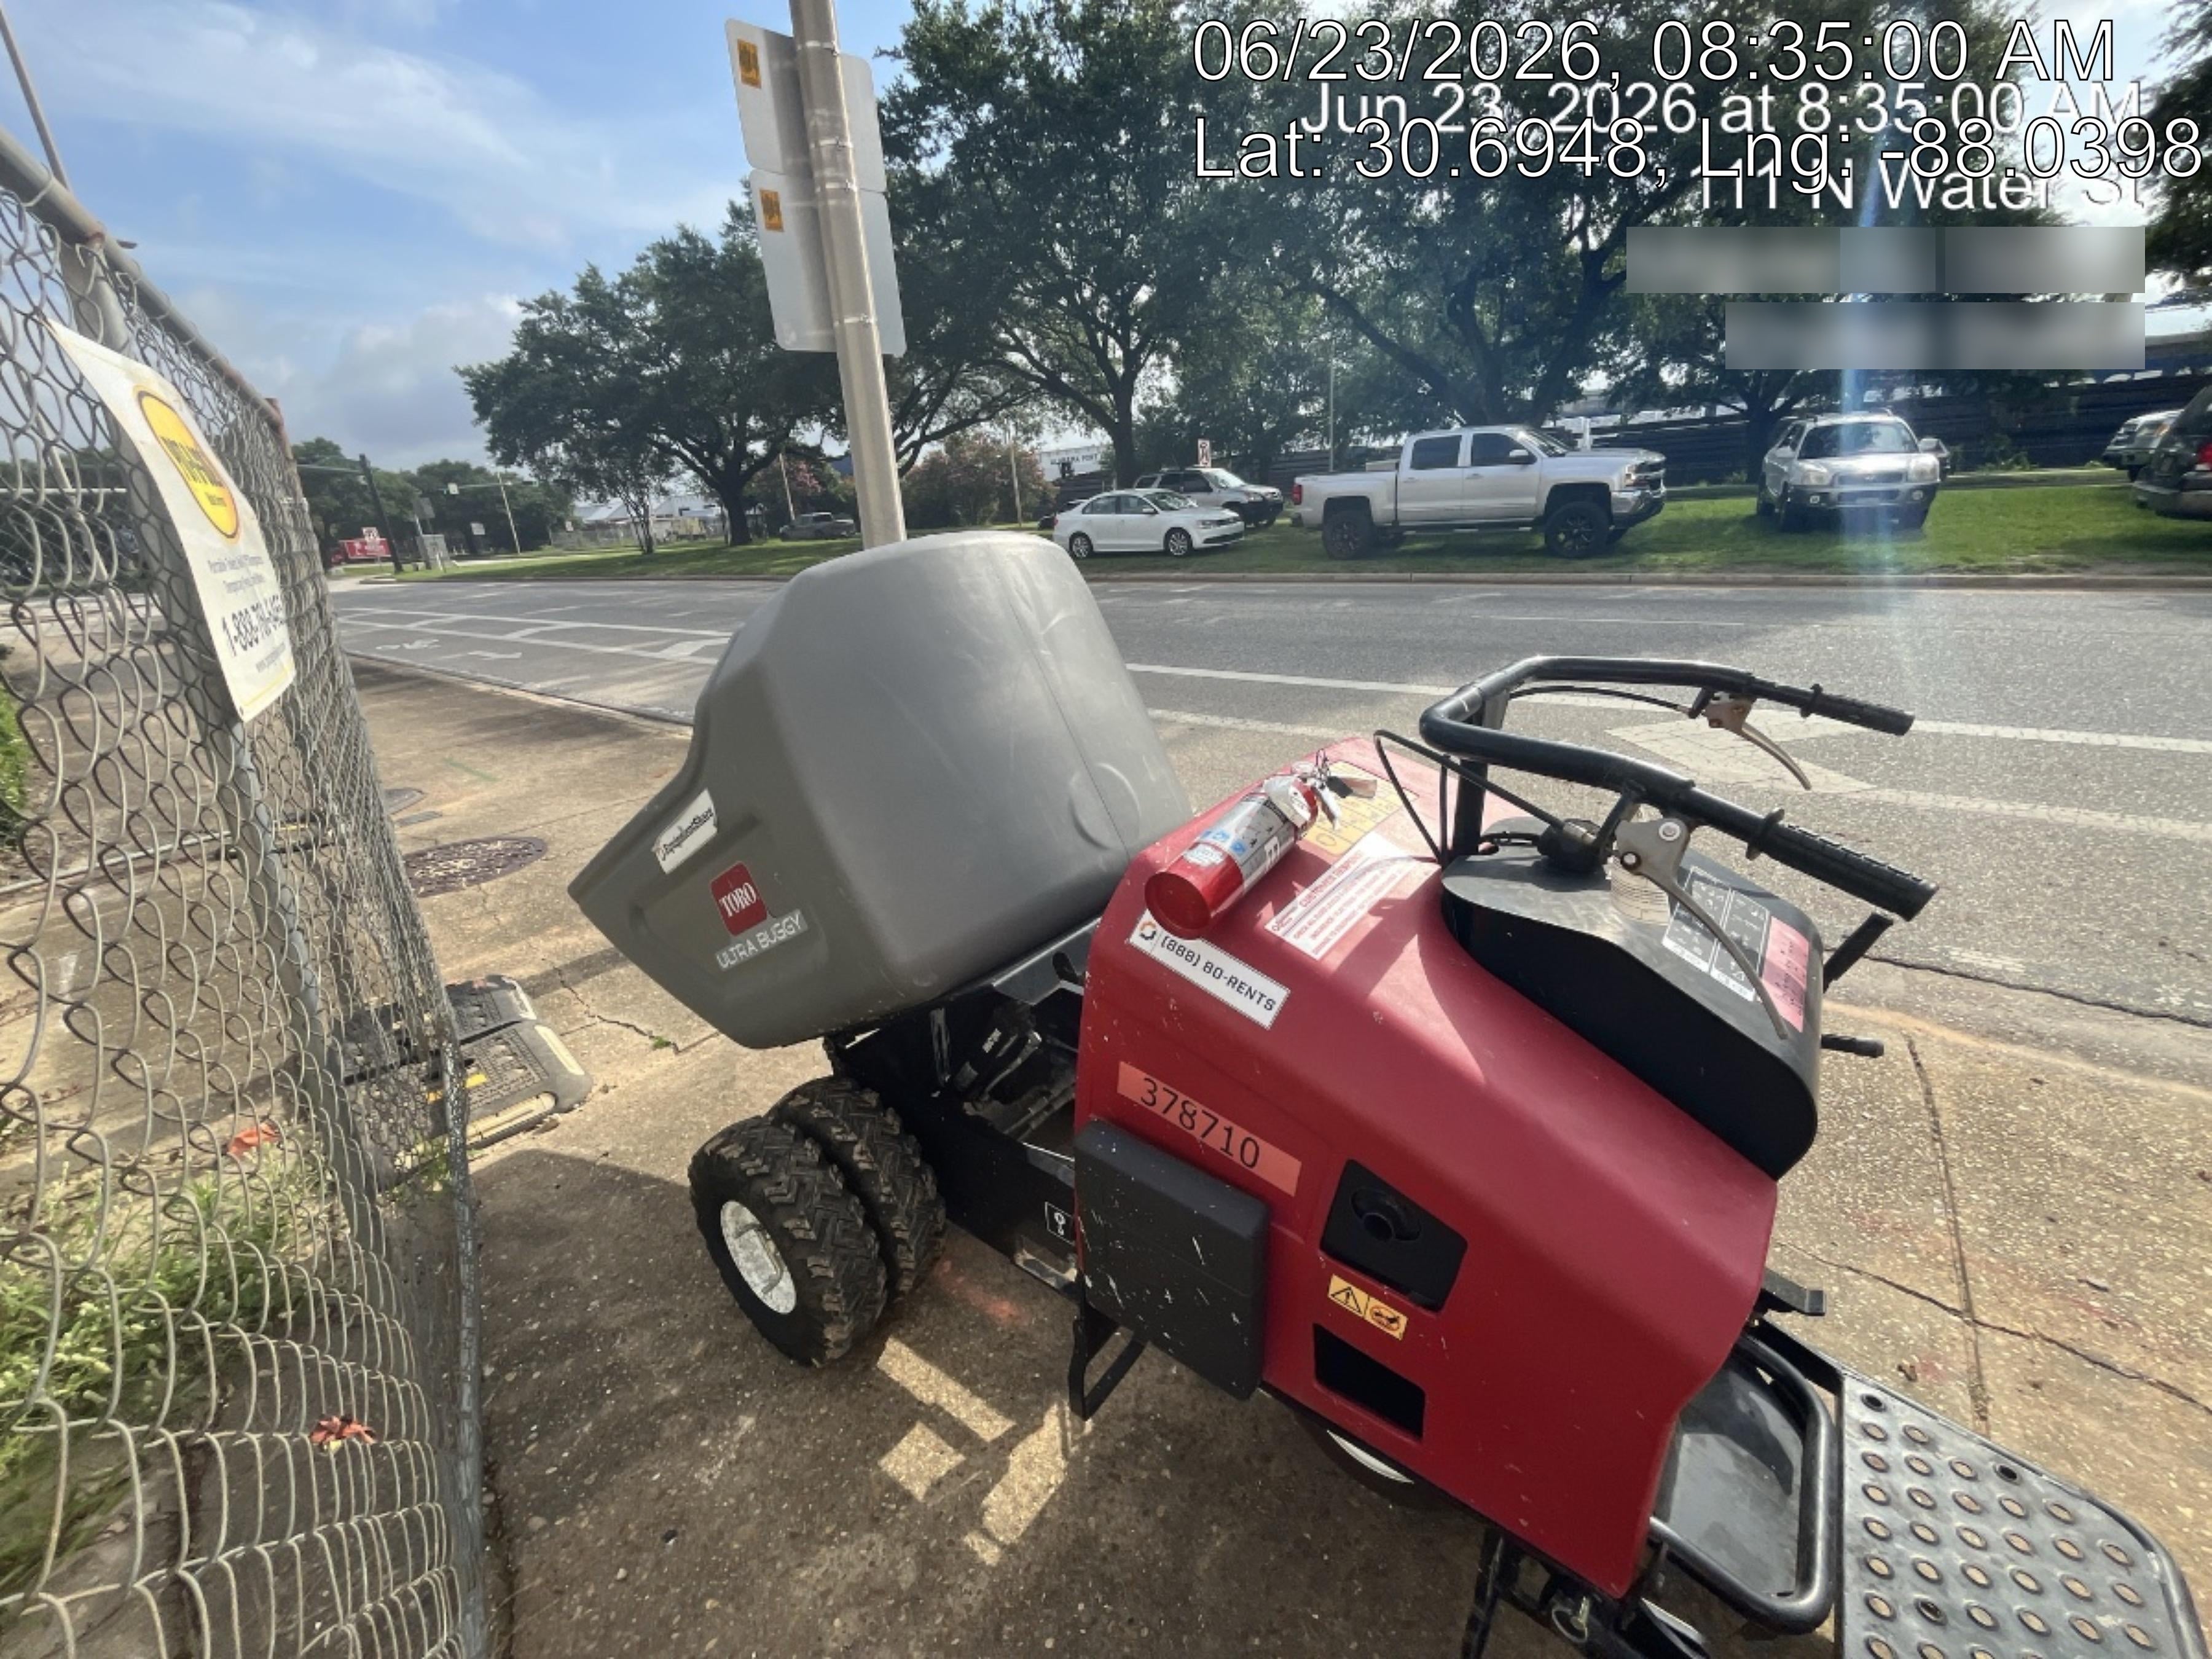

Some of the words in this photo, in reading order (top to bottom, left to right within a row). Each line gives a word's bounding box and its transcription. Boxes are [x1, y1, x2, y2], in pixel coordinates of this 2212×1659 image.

[719, 882, 757, 917] TORO
[716, 939, 758, 969] ULTRA
[756, 913, 802, 948] BUGGY
[1161, 936, 1201, 967] (888)
[1202, 961, 1276, 1011] 80-RENTS
[1140, 1077, 1260, 1169] 378710
